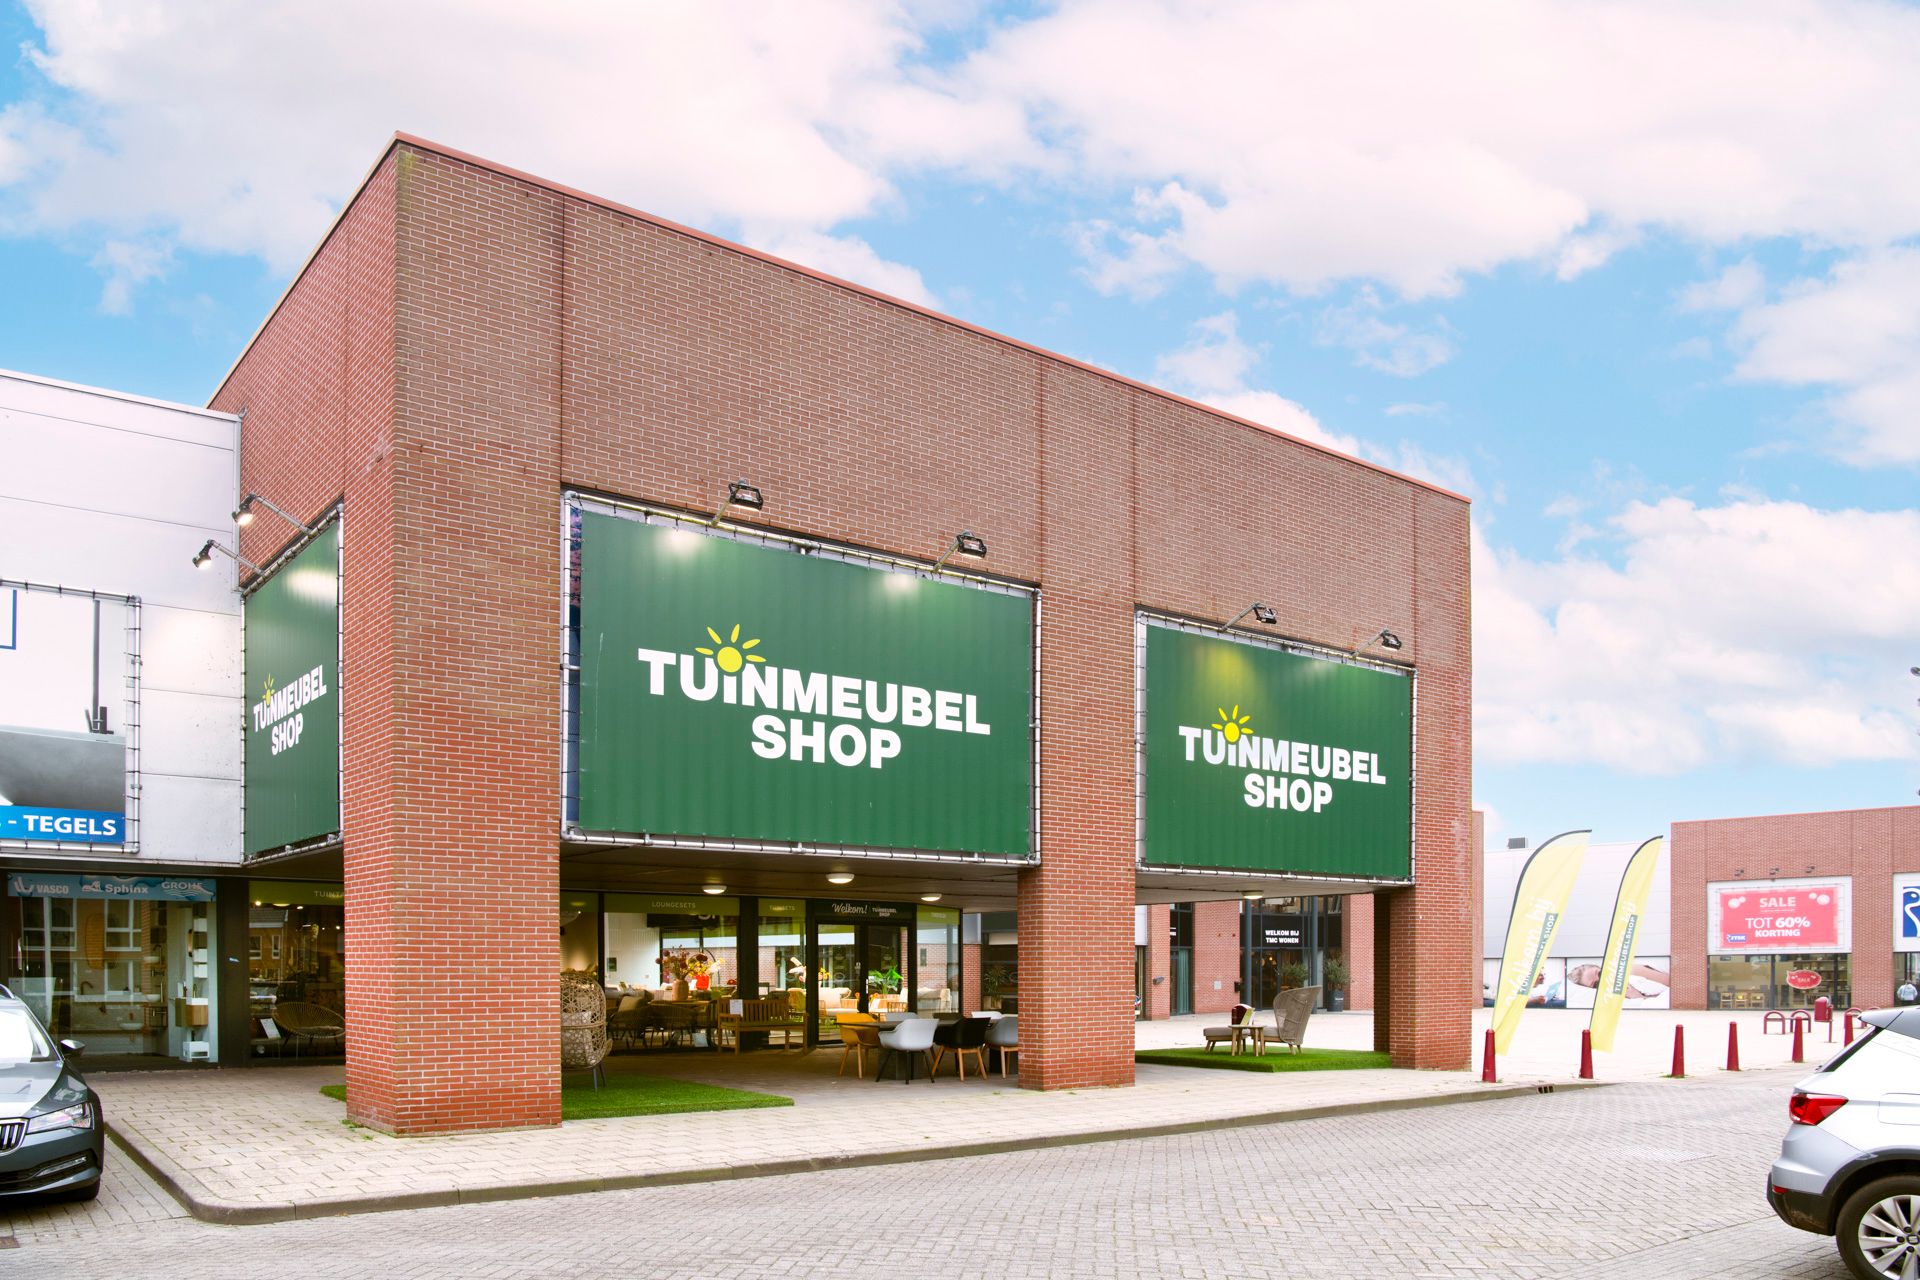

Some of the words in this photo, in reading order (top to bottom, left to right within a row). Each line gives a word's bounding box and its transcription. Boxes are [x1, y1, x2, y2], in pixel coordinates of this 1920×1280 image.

[252, 663, 328, 733] TUINMEUBEL
[637, 646, 991, 736] TUINMEUBEL
[271, 712, 304, 756] SHOP
[751, 714, 902, 769] SHOP
[1178, 724, 1387, 785] TUINMEUBEL
[1243, 772, 1334, 814] SHOP
[23, 814, 117, 836] TEGELS
[36, 884, 70, 895] VASCO
[104, 883, 149, 895] Sphinx
[651, 901, 697, 909] LOUNGESETS
[831, 903, 868, 915] Welkom!
[1760, 896, 1796, 908] SALE
[1265, 929, 1290, 937] WELKOM
[1290, 929, 1300, 937] BIJ
[1745, 917, 1773, 929] TOT
[1775, 916, 1811, 928] 60%
[1755, 929, 1801, 938] KORTING
[1614, 915, 1637, 993] TUINMEUBELSHOP
